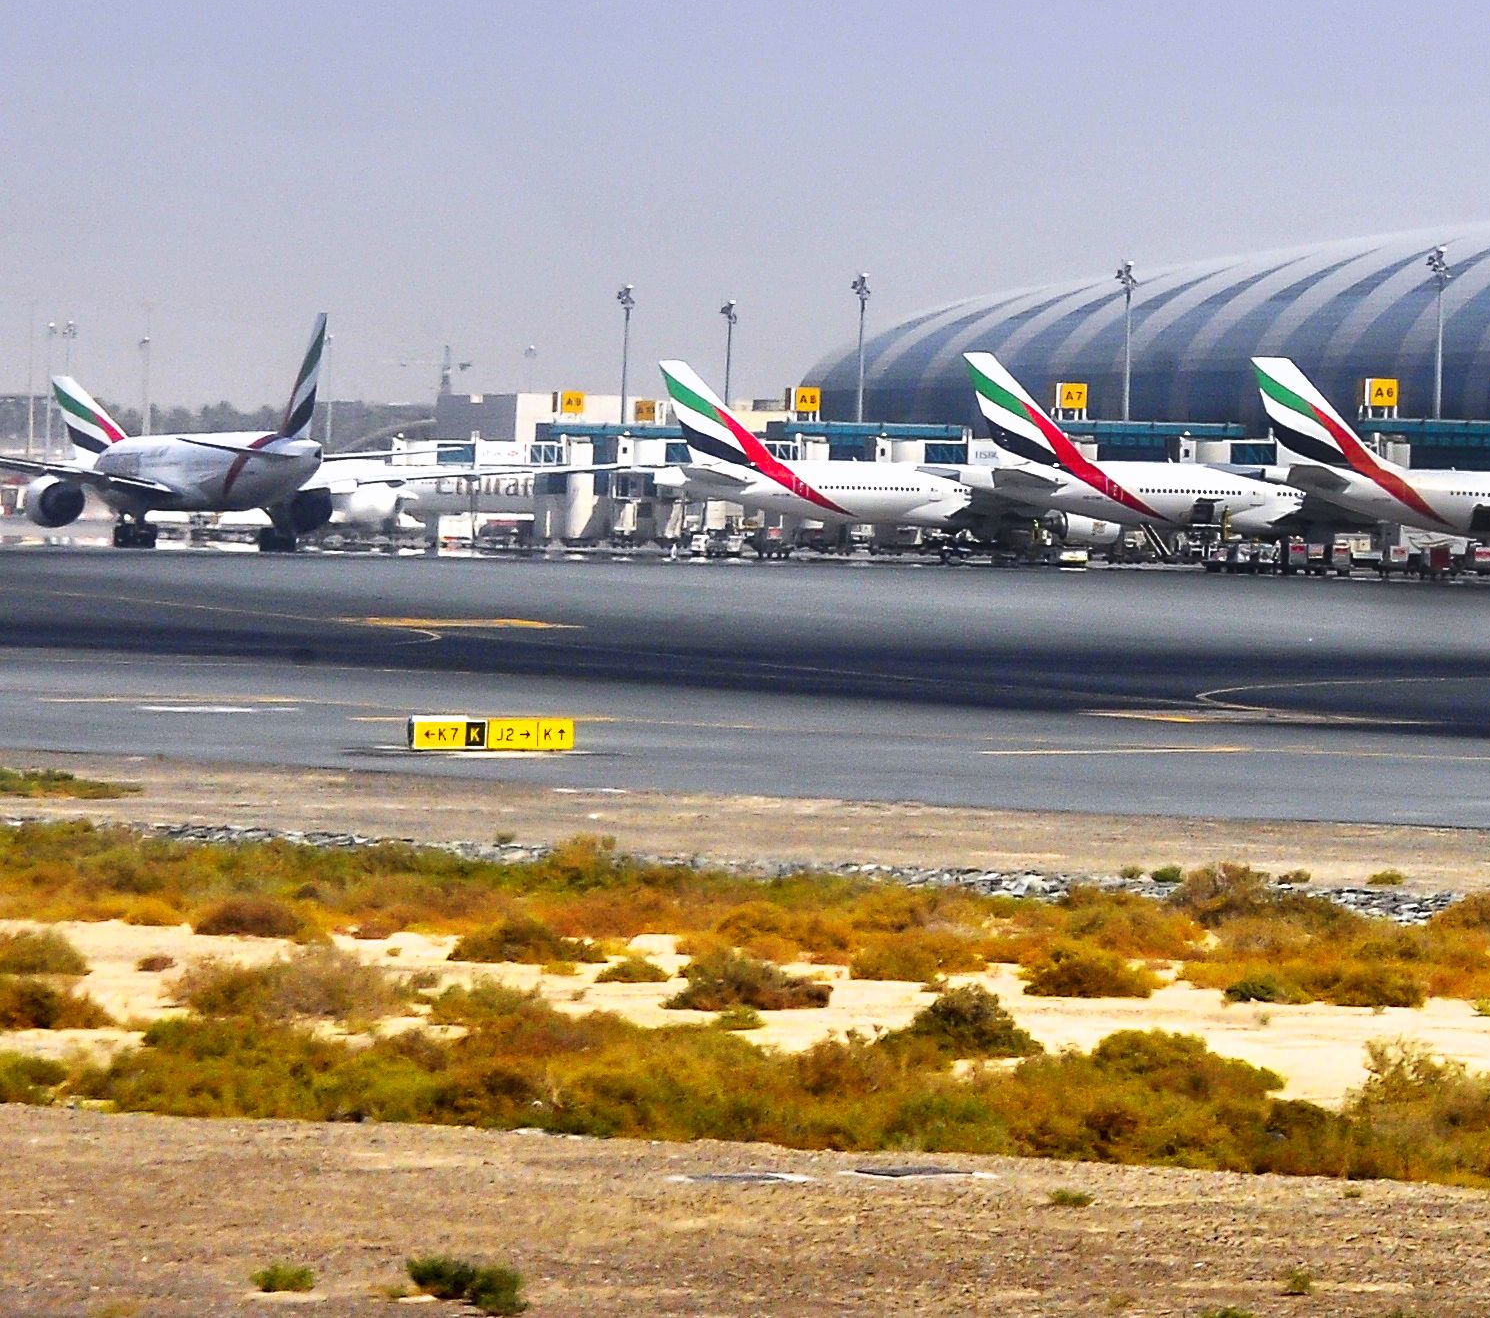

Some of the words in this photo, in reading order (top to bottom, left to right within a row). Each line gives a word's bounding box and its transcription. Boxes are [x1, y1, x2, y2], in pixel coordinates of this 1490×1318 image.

[438, 727, 459, 742] K7
[470, 726, 481, 742] K
[496, 727, 515, 742] J2
[544, 728, 553, 741] K
